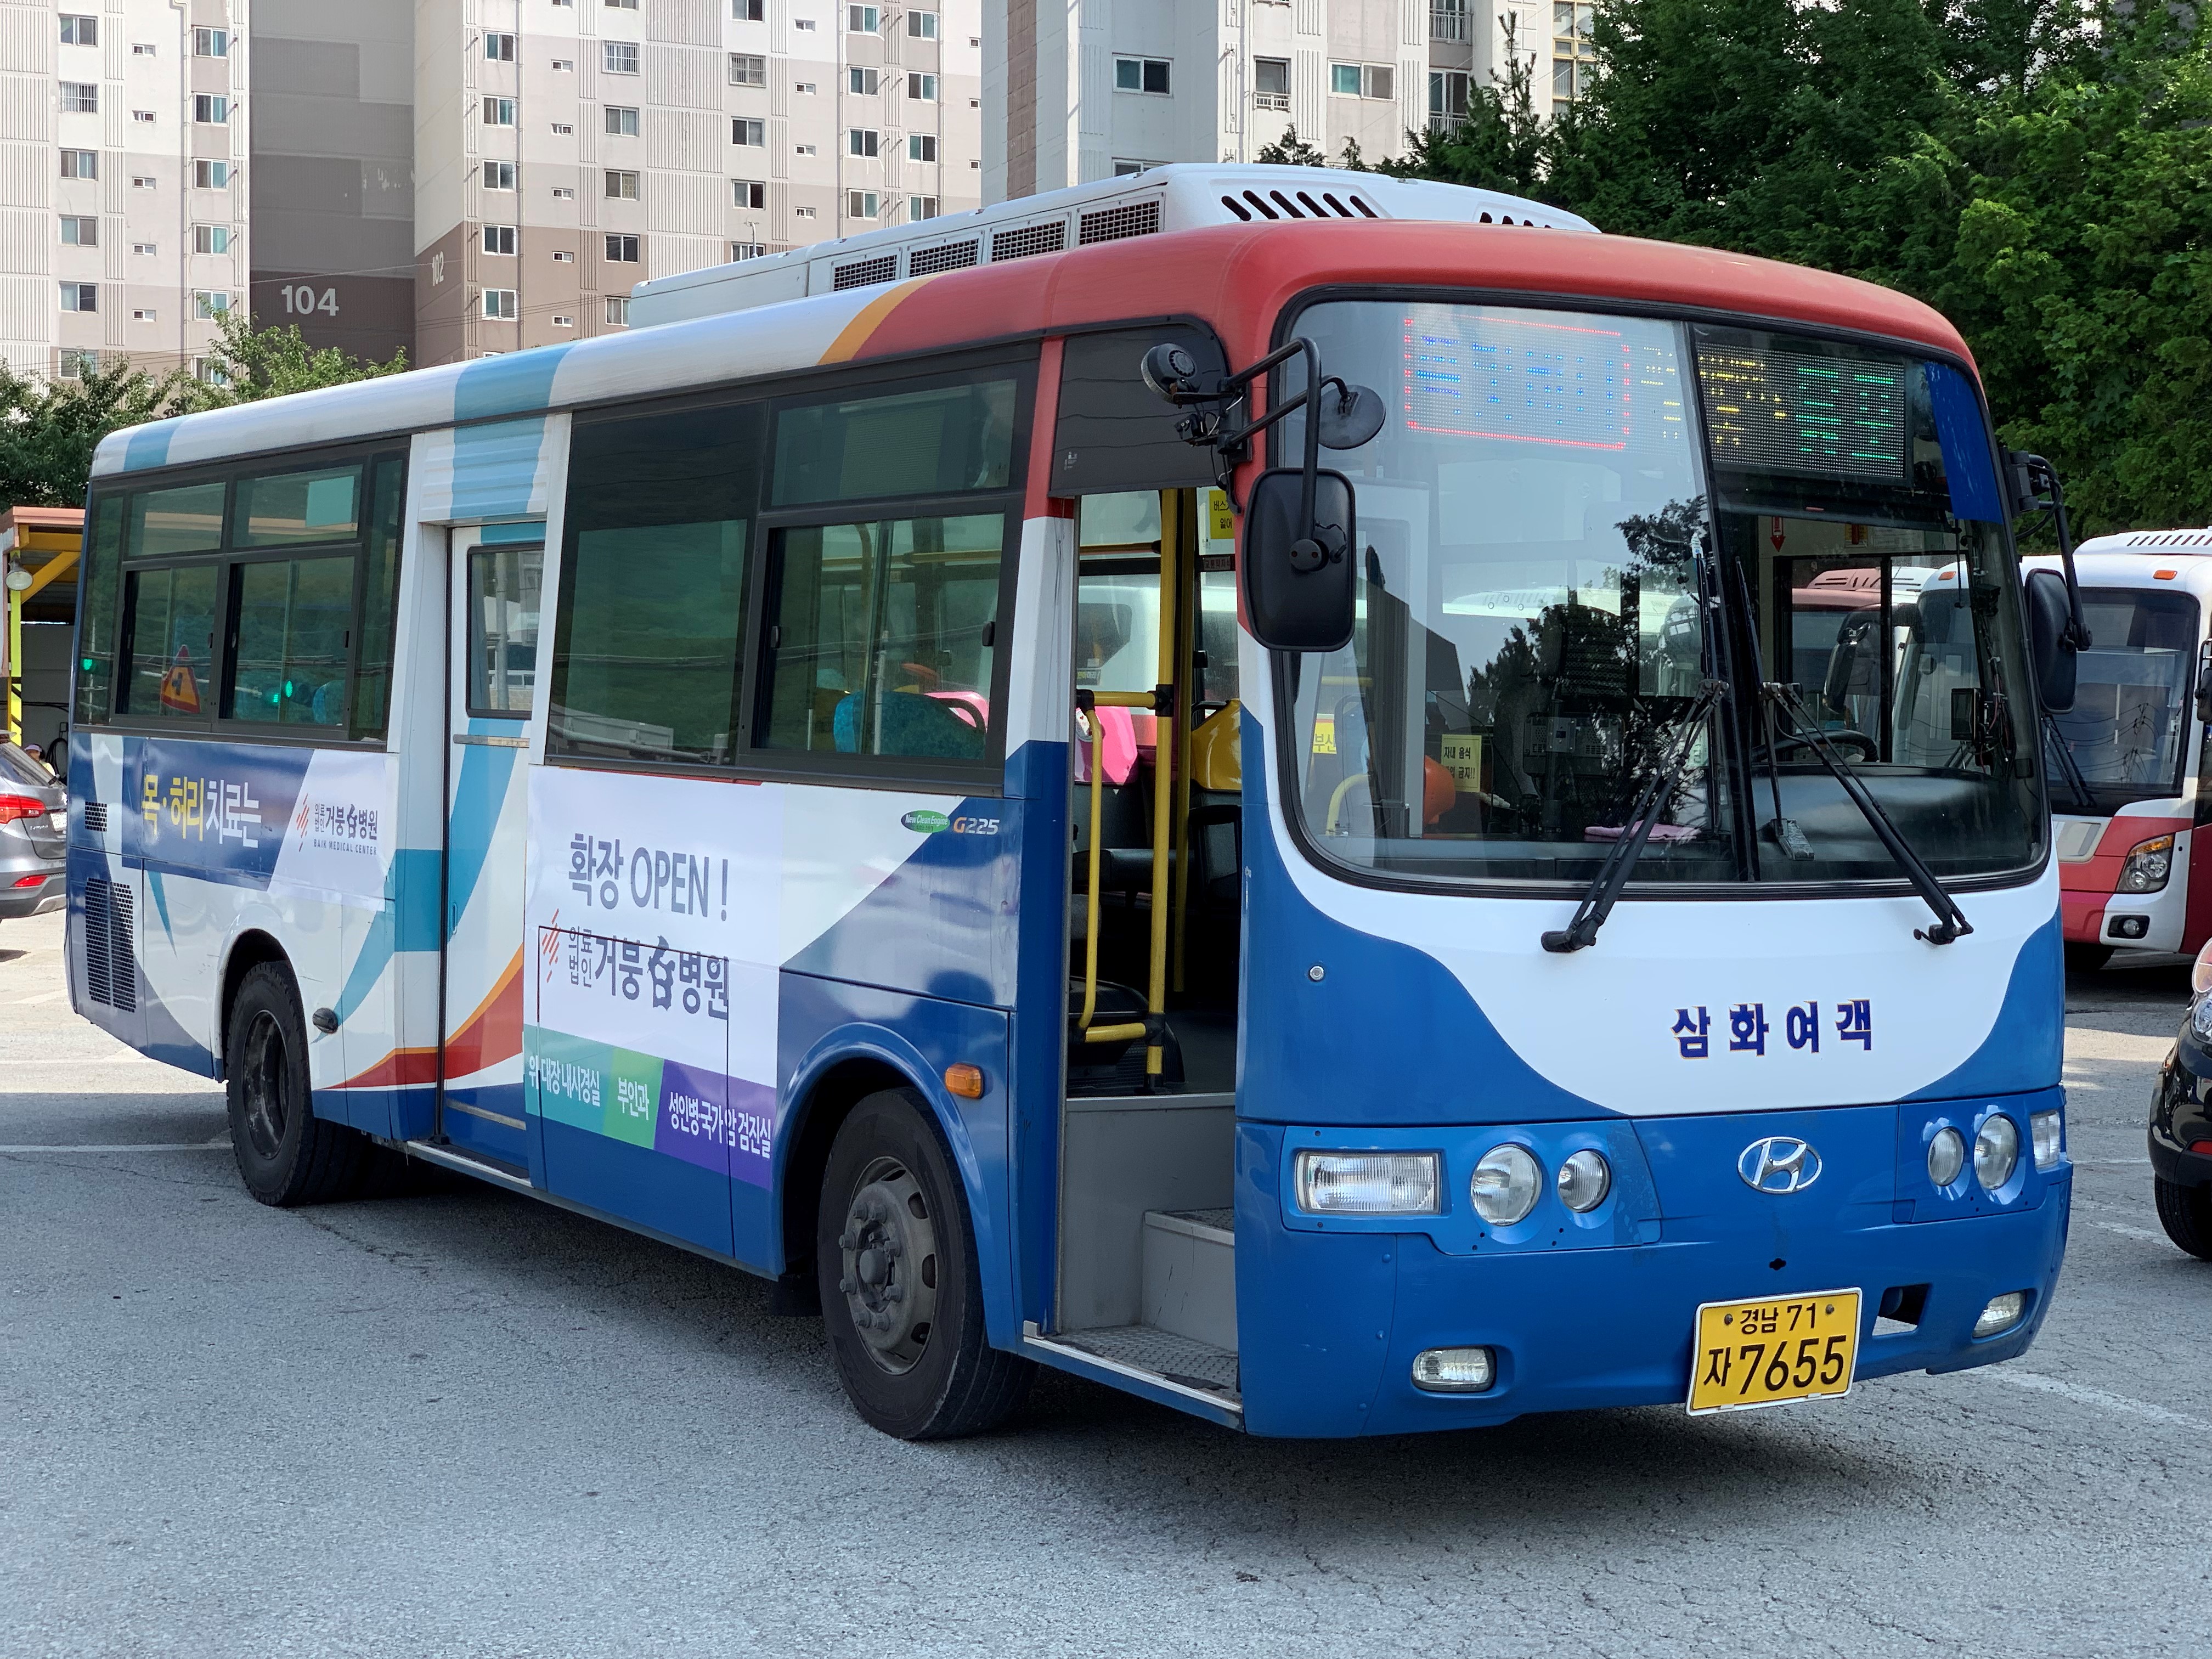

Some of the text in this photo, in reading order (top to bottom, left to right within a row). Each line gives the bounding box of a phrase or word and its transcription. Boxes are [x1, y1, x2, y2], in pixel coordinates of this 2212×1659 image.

[432, 251, 444, 286] 102
[281, 285, 339, 316] 104
[1214, 500, 1229, 511] 버스
[1459, 747, 1471, 759] 음식
[1458, 766, 1475, 780] 금지!!
[905, 814, 949, 827] New Clean Engine
[953, 816, 1000, 835] G225
[314, 839, 377, 855] BAIK MEDICAL CENTER
[568, 833, 624, 910] 확장
[630, 847, 709, 917] OPEN
[568, 926, 592, 953] 의료
[569, 955, 592, 988] 법인
[1670, 998, 1872, 1060] 삼화여객
[618, 1077, 650, 1120] 부인과
[1740, 1302, 1816, 1335] 경남 71
